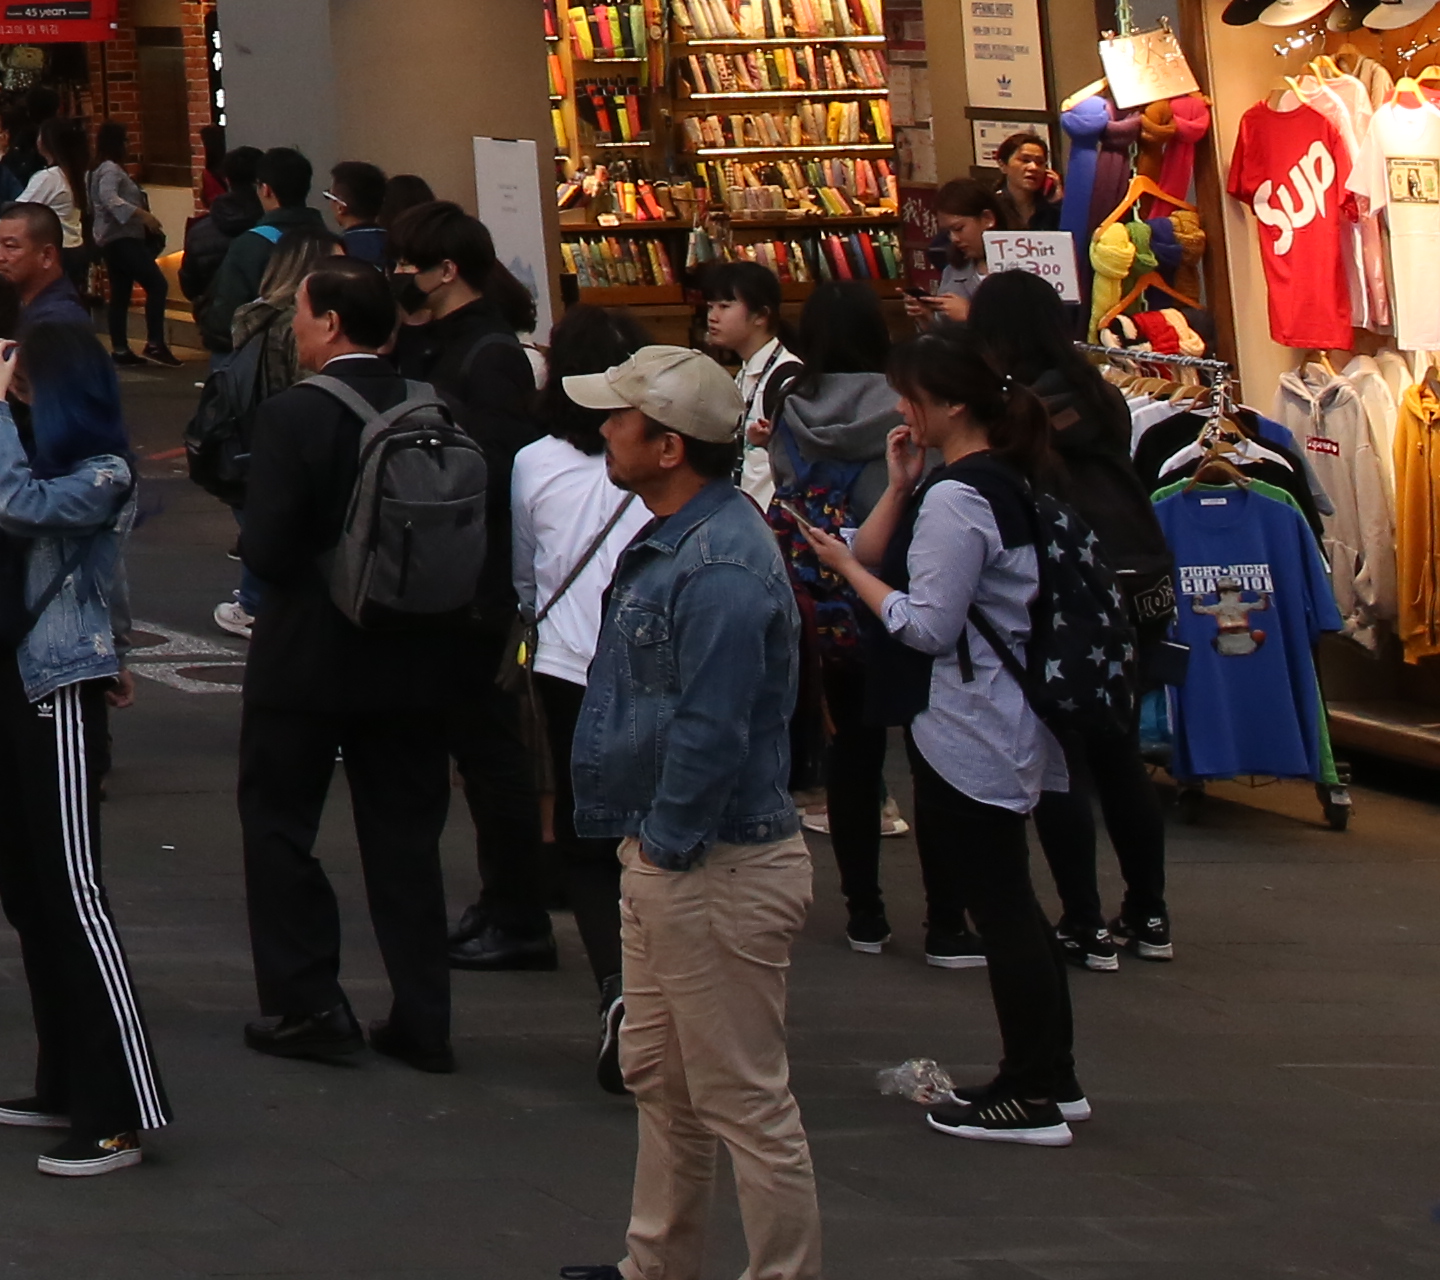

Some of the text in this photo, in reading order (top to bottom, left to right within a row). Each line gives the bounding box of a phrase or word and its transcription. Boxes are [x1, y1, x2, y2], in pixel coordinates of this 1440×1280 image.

[25, 8, 37, 17] 45
[39, 7, 67, 18] years
[991, 237, 1055, 260] T-Shirt
[1180, 563, 1271, 577] FIGHT NIGHT
[1181, 575, 1274, 594] CHAPION
